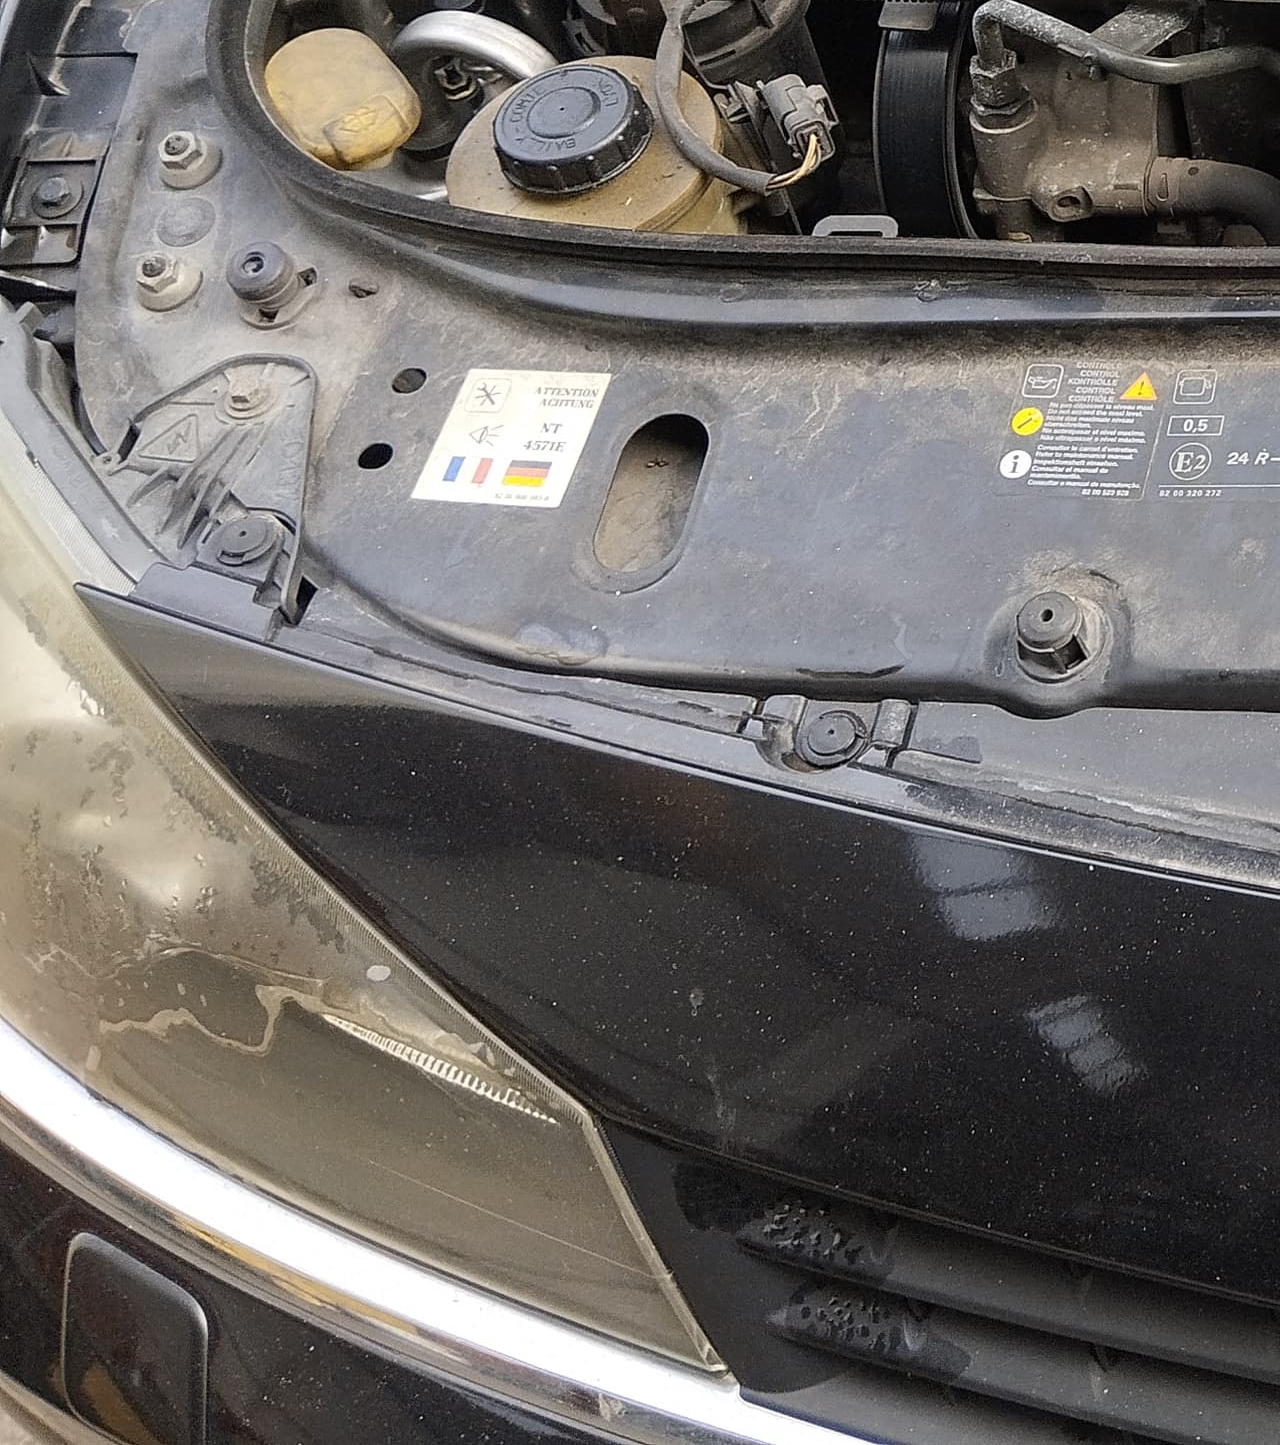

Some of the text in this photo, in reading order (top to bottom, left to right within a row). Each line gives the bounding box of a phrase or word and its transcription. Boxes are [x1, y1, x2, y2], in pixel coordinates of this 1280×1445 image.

[534, 387, 599, 397] ATTENTION
[539, 398, 594, 409] ACHTUNG
[541, 423, 562, 434] NT
[1183, 419, 1208, 433] 0,5
[523, 440, 566, 452] 4571E
[1175, 452, 1206, 472] E2
[1226, 452, 1249, 465] 24
